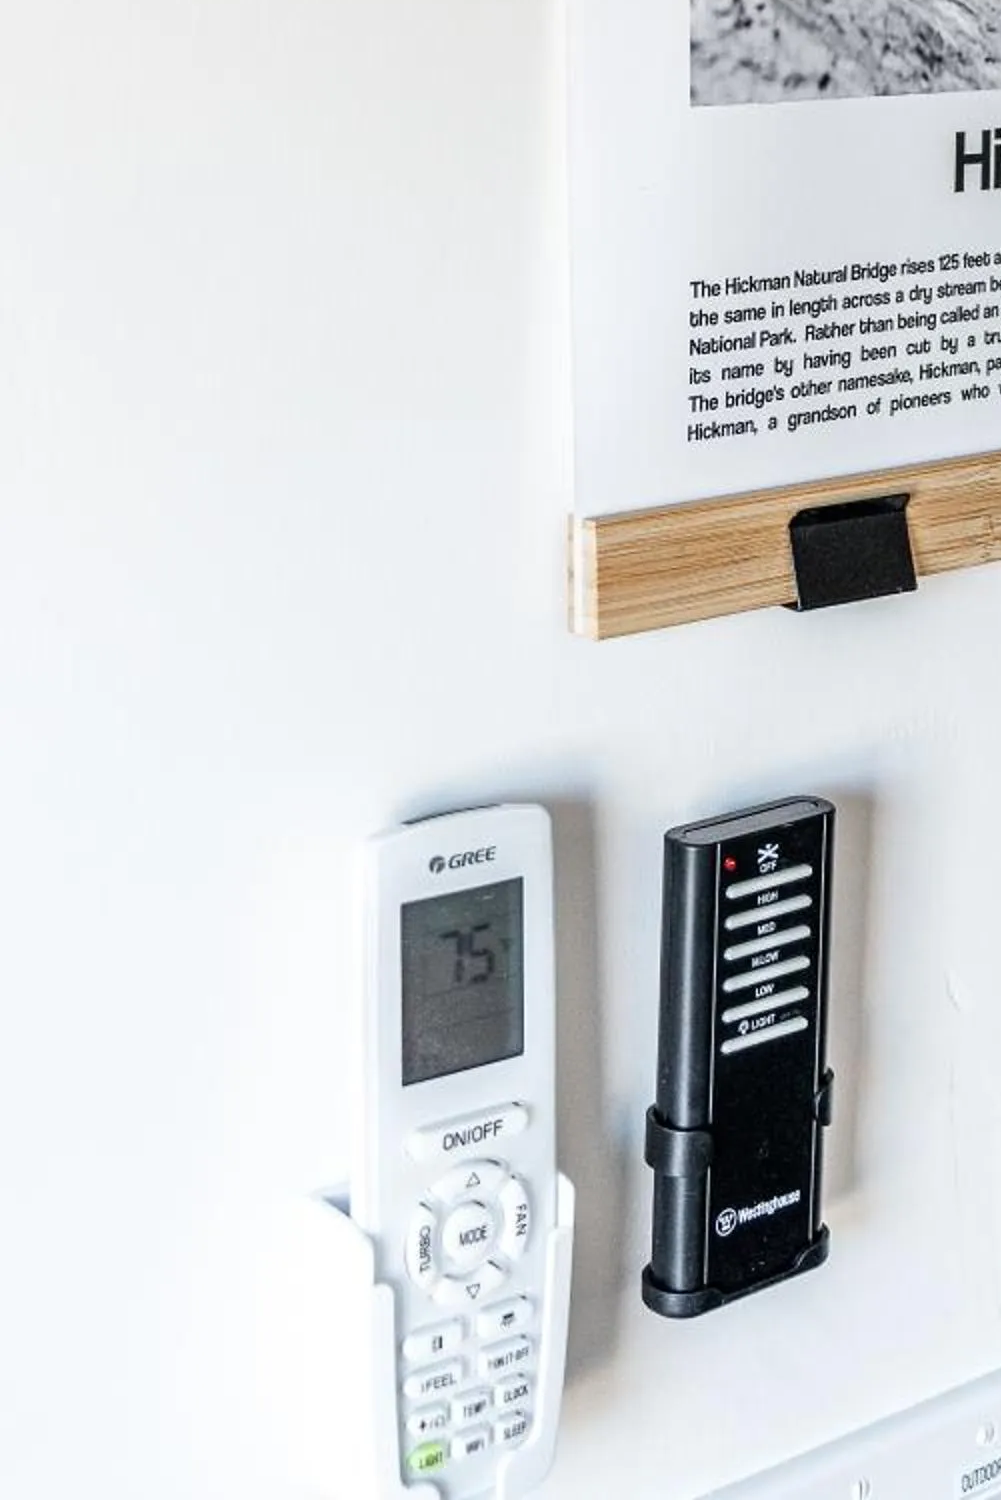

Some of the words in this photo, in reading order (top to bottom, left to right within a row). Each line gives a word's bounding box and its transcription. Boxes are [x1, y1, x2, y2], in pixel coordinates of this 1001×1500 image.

[690, 280, 722, 298] The
[725, 276, 791, 296] Hickman
[794, 265, 848, 288] Natural
[850, 262, 898, 283] Bridge
[900, 258, 935, 276] rises
[938, 253, 960, 272] 125
[962, 252, 991, 268] feet
[690, 308, 719, 328] the
[724, 306, 766, 324] same
[771, 301, 785, 318] in
[789, 294, 838, 318] length
[842, 292, 891, 310] across
[895, 290, 904, 304] a
[908, 284, 932, 305] dry
[936, 280, 986, 298] stream
[690, 331, 757, 356] National
[760, 327, 796, 348] Park.
[804, 322, 856, 343] Rather
[859, 316, 894, 335] than
[897, 310, 937, 331] being
[940, 304, 980, 324] called
[983, 305, 1000, 319] an
[689, 367, 712, 385] its
[721, 363, 764, 380] name
[774, 356, 794, 378] by
[803, 349, 852, 370] having
[860, 344, 897, 362] been
[906, 338, 932, 356] cut
[940, 334, 958, 355] by
[967, 335, 976, 348] a
[688, 394, 719, 413] The
[725, 384, 785, 409] bridge's
[790, 379, 832, 398] other
[838, 368, 914, 392] namesake,
[919, 361, 981, 381] Hickman,
[688, 420, 758, 442] Hickman,
[768, 416, 778, 430] a
[788, 404, 857, 432] grandson
[866, 397, 882, 415] of
[890, 391, 952, 416] pioneers
[960, 384, 990, 401] who
[448, 845, 497, 869] GREE
[759, 861, 777, 874] OFF
[757, 891, 779, 905] HIGH
[440, 923, 495, 984] 75
[755, 983, 775, 998] LOW
[751, 1013, 776, 1031] LIGHT
[443, 1118, 504, 1151] ON/OFF
[515, 1203, 527, 1236] FAN
[738, 1189, 800, 1225] Westinghouse
[419, 1224, 431, 1274] TURBO
[459, 1225, 488, 1246] MODE
